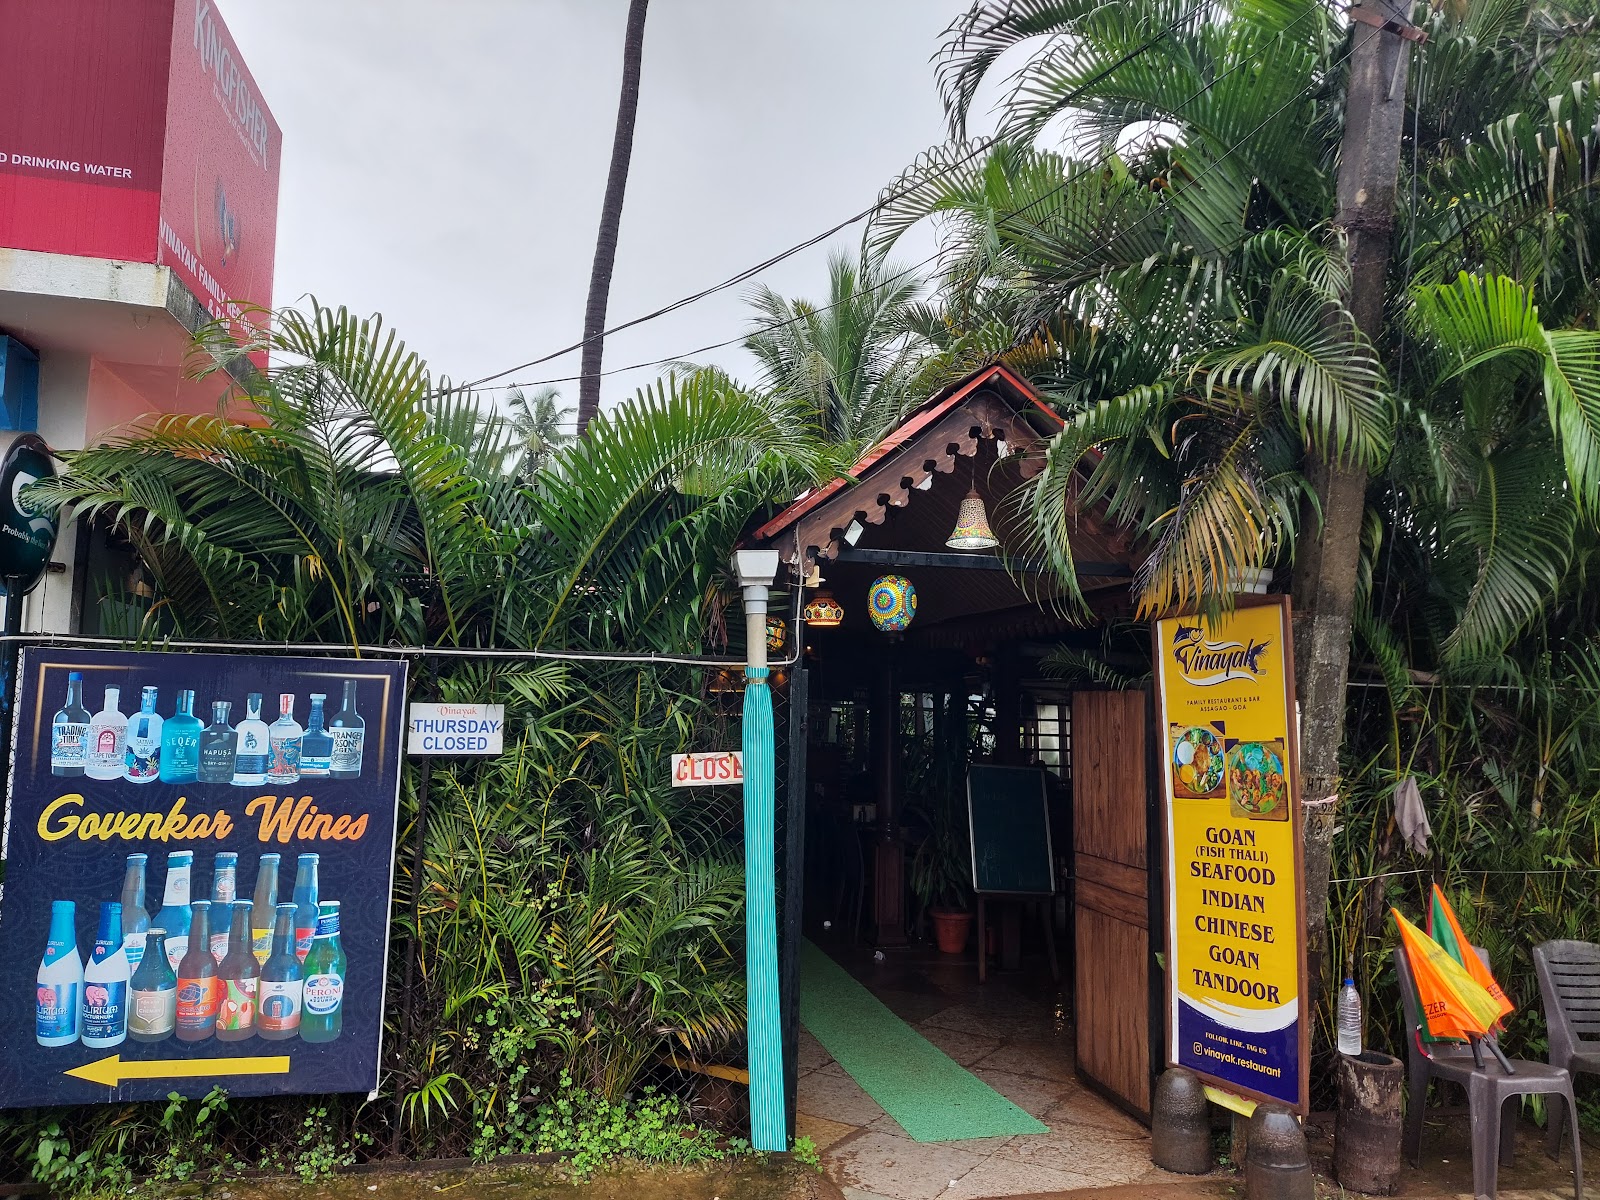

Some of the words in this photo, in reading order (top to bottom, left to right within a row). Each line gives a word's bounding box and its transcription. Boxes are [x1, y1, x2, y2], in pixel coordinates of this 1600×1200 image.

[194, 0, 267, 171] KINGFISHER
[12, 154, 81, 172] DRINKING
[84, 163, 132, 179] WATER
[160, 215, 198, 277] VINAYAK
[198, 263, 227, 307] FAMILY
[1, 523, 31, 544] Probably
[1173, 637, 1264, 677] Vinayak
[437, 706, 478, 718] Vinayak
[1207, 697, 1242, 705] RESTAURANT
[414, 719, 499, 733] THURSDAY
[423, 736, 488, 750] CLOSED
[37, 793, 234, 843] Govenkar
[244, 795, 369, 843] Wines
[1205, 827, 1256, 846] GOAN
[1195, 845, 1225, 859] (FISH
[1228, 848, 1269, 865] THALI)
[1190, 861, 1276, 886] SEAFOOD
[1202, 888, 1265, 914] INDIAN
[1194, 915, 1275, 944] CHINESE
[1208, 944, 1260, 970] GOAN
[306, 987, 341, 996] PERONI
[1192, 968, 1281, 1004] TANDOOR
[1246, 1043, 1258, 1052] TAG
[1258, 1047, 1268, 1055] US
[1203, 1046, 1281, 1078] vinayak.restaurant
